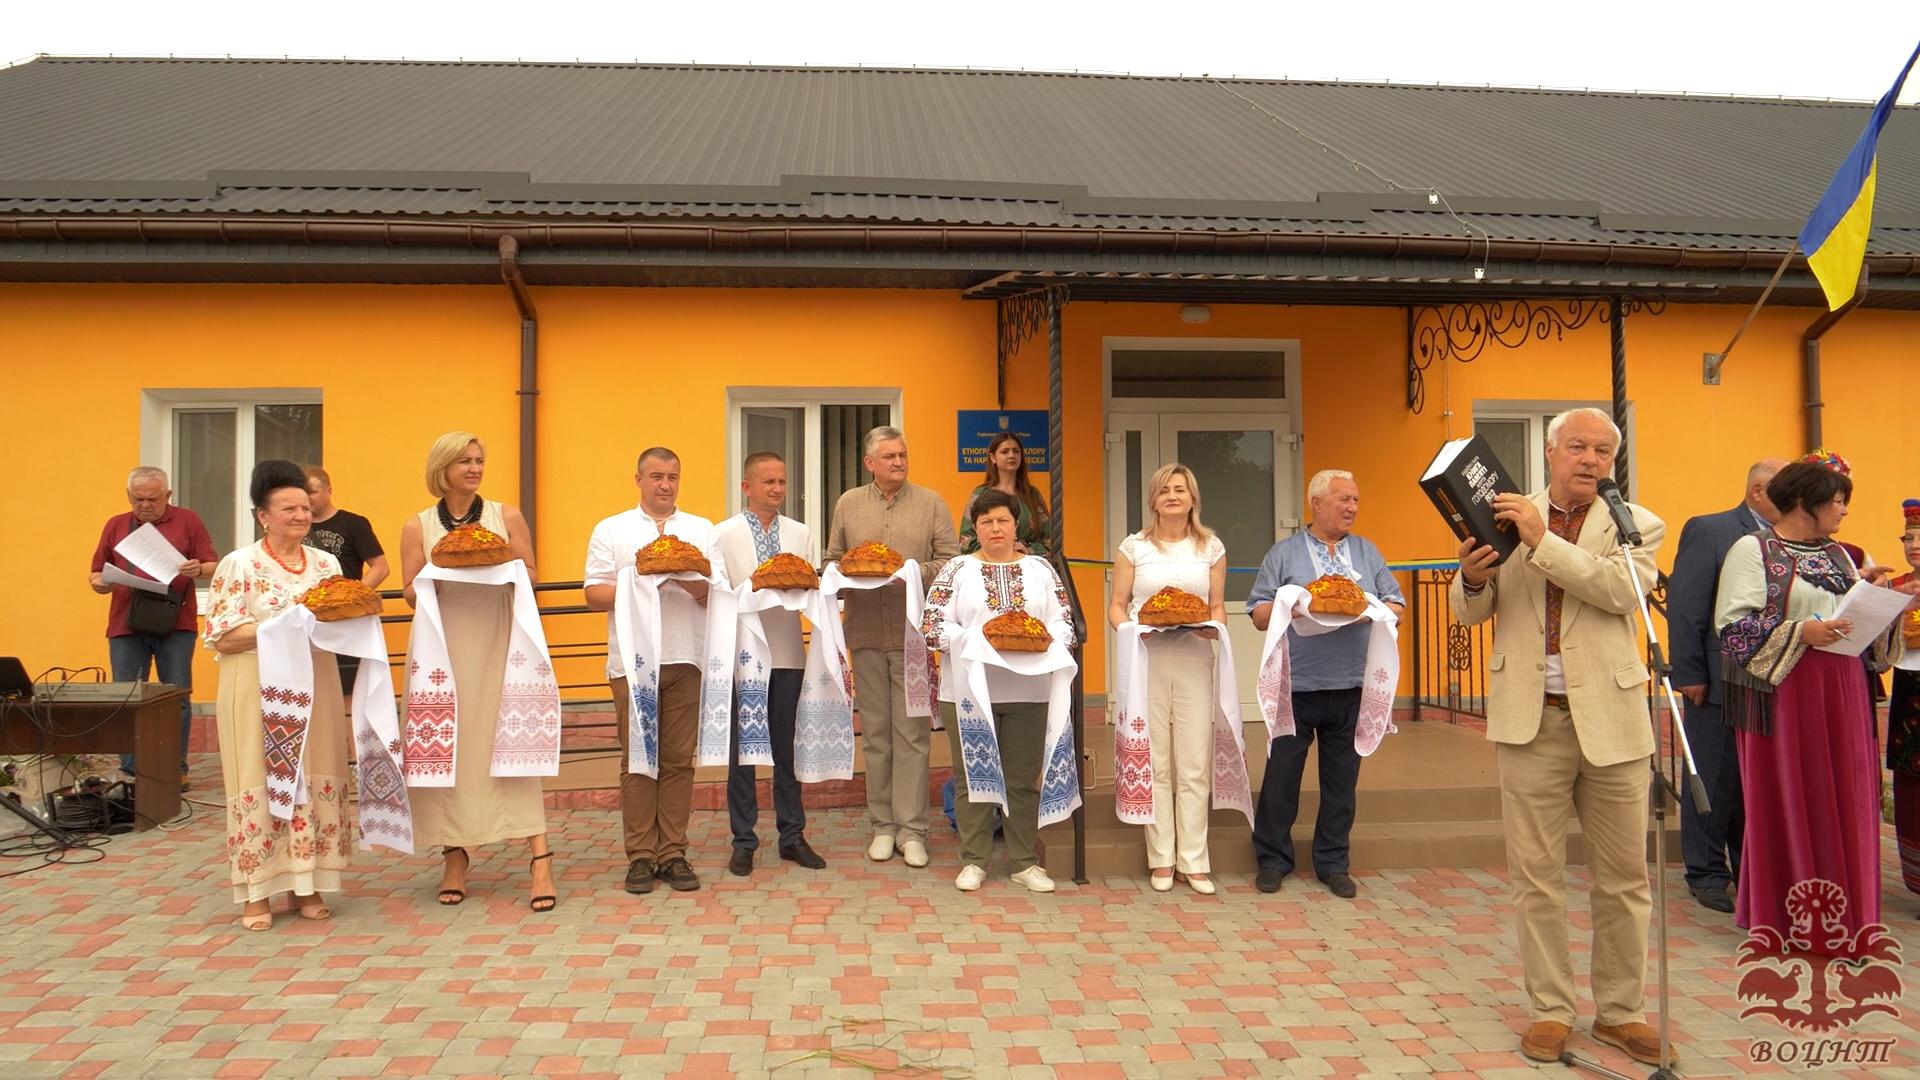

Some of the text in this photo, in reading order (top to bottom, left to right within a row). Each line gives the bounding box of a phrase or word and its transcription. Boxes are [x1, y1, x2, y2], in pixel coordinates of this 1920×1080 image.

[1023, 447, 1046, 455] КЛОРУ
[963, 456, 973, 464] ТА
[1024, 456, 1046, 464] ЕСЕЛ
